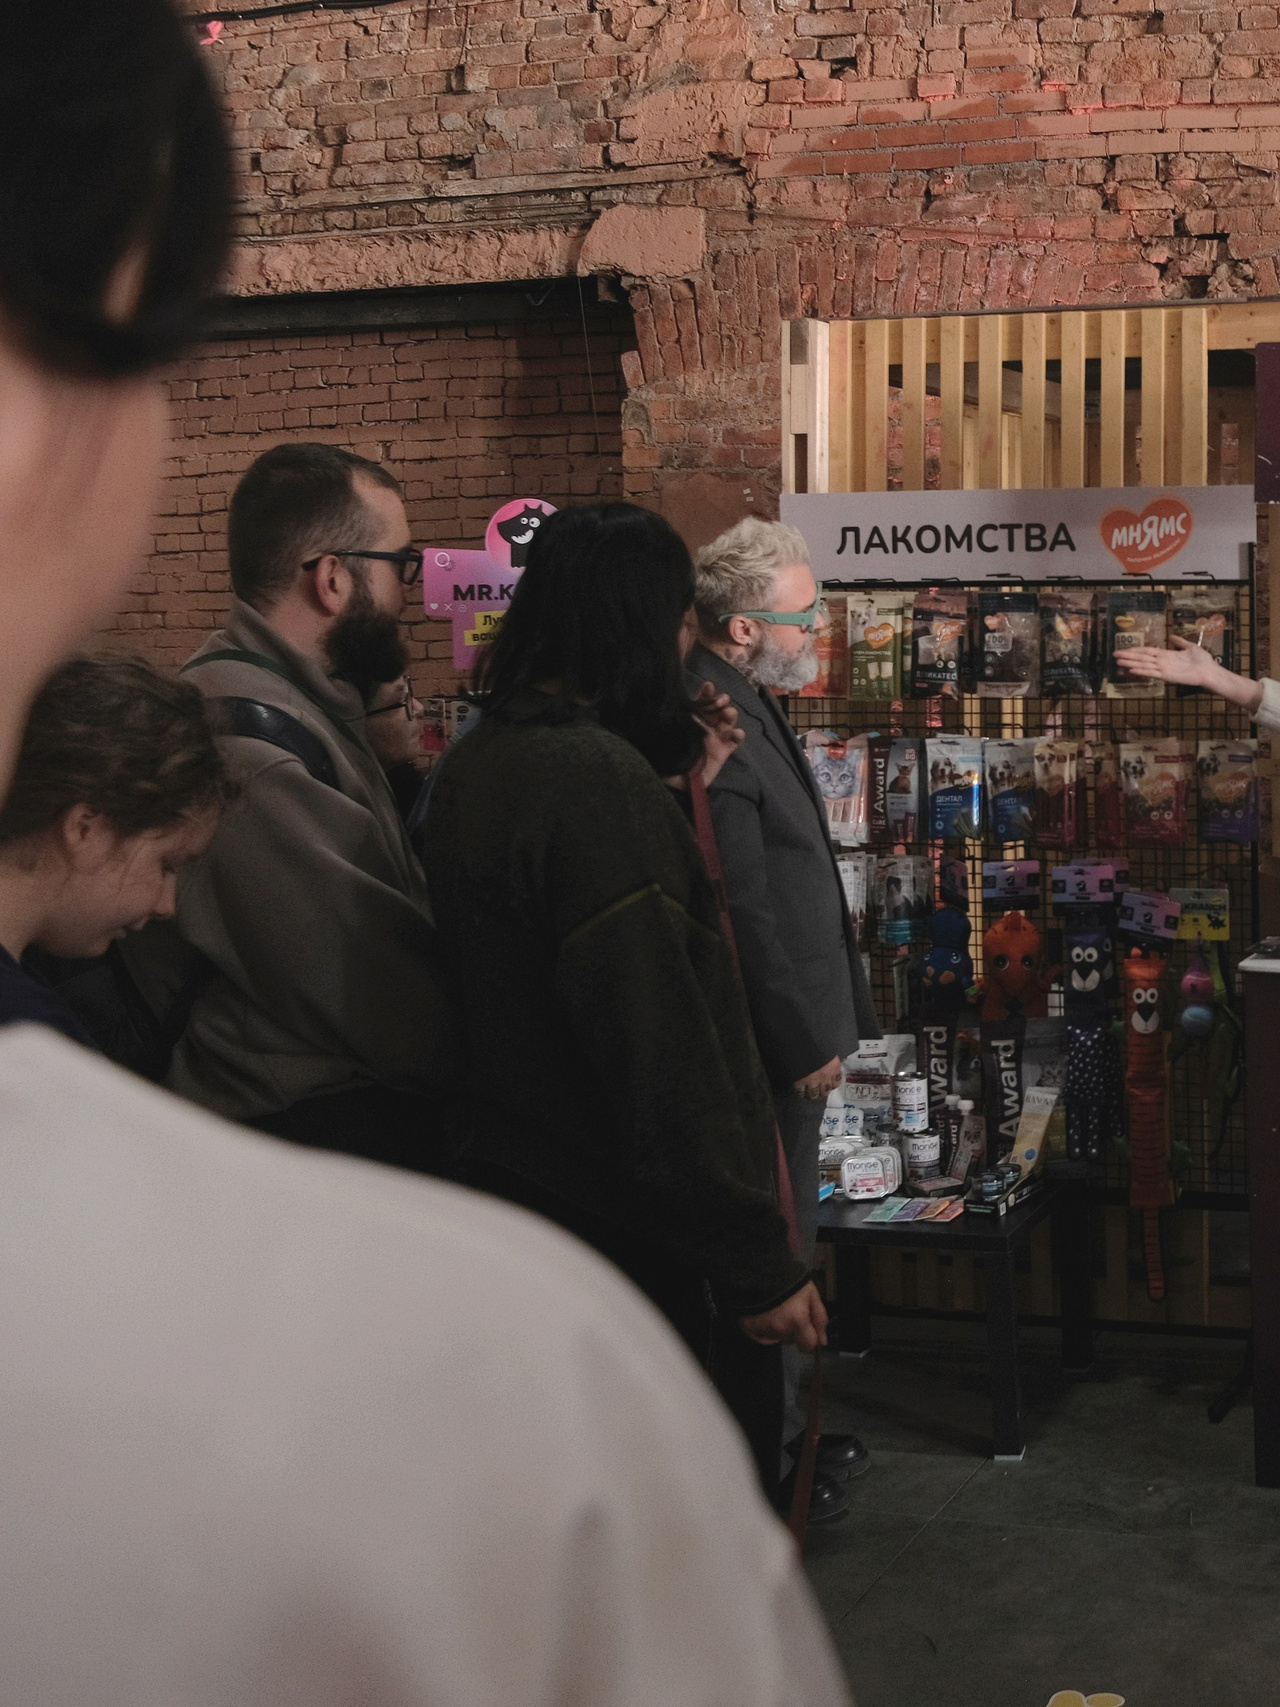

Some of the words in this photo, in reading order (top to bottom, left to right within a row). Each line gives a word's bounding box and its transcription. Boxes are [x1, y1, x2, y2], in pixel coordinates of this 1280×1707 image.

[837, 523, 1076, 555] ЛАКОМСТВА
[453, 584, 515, 601] MR.K
[873, 757, 886, 813] Award
